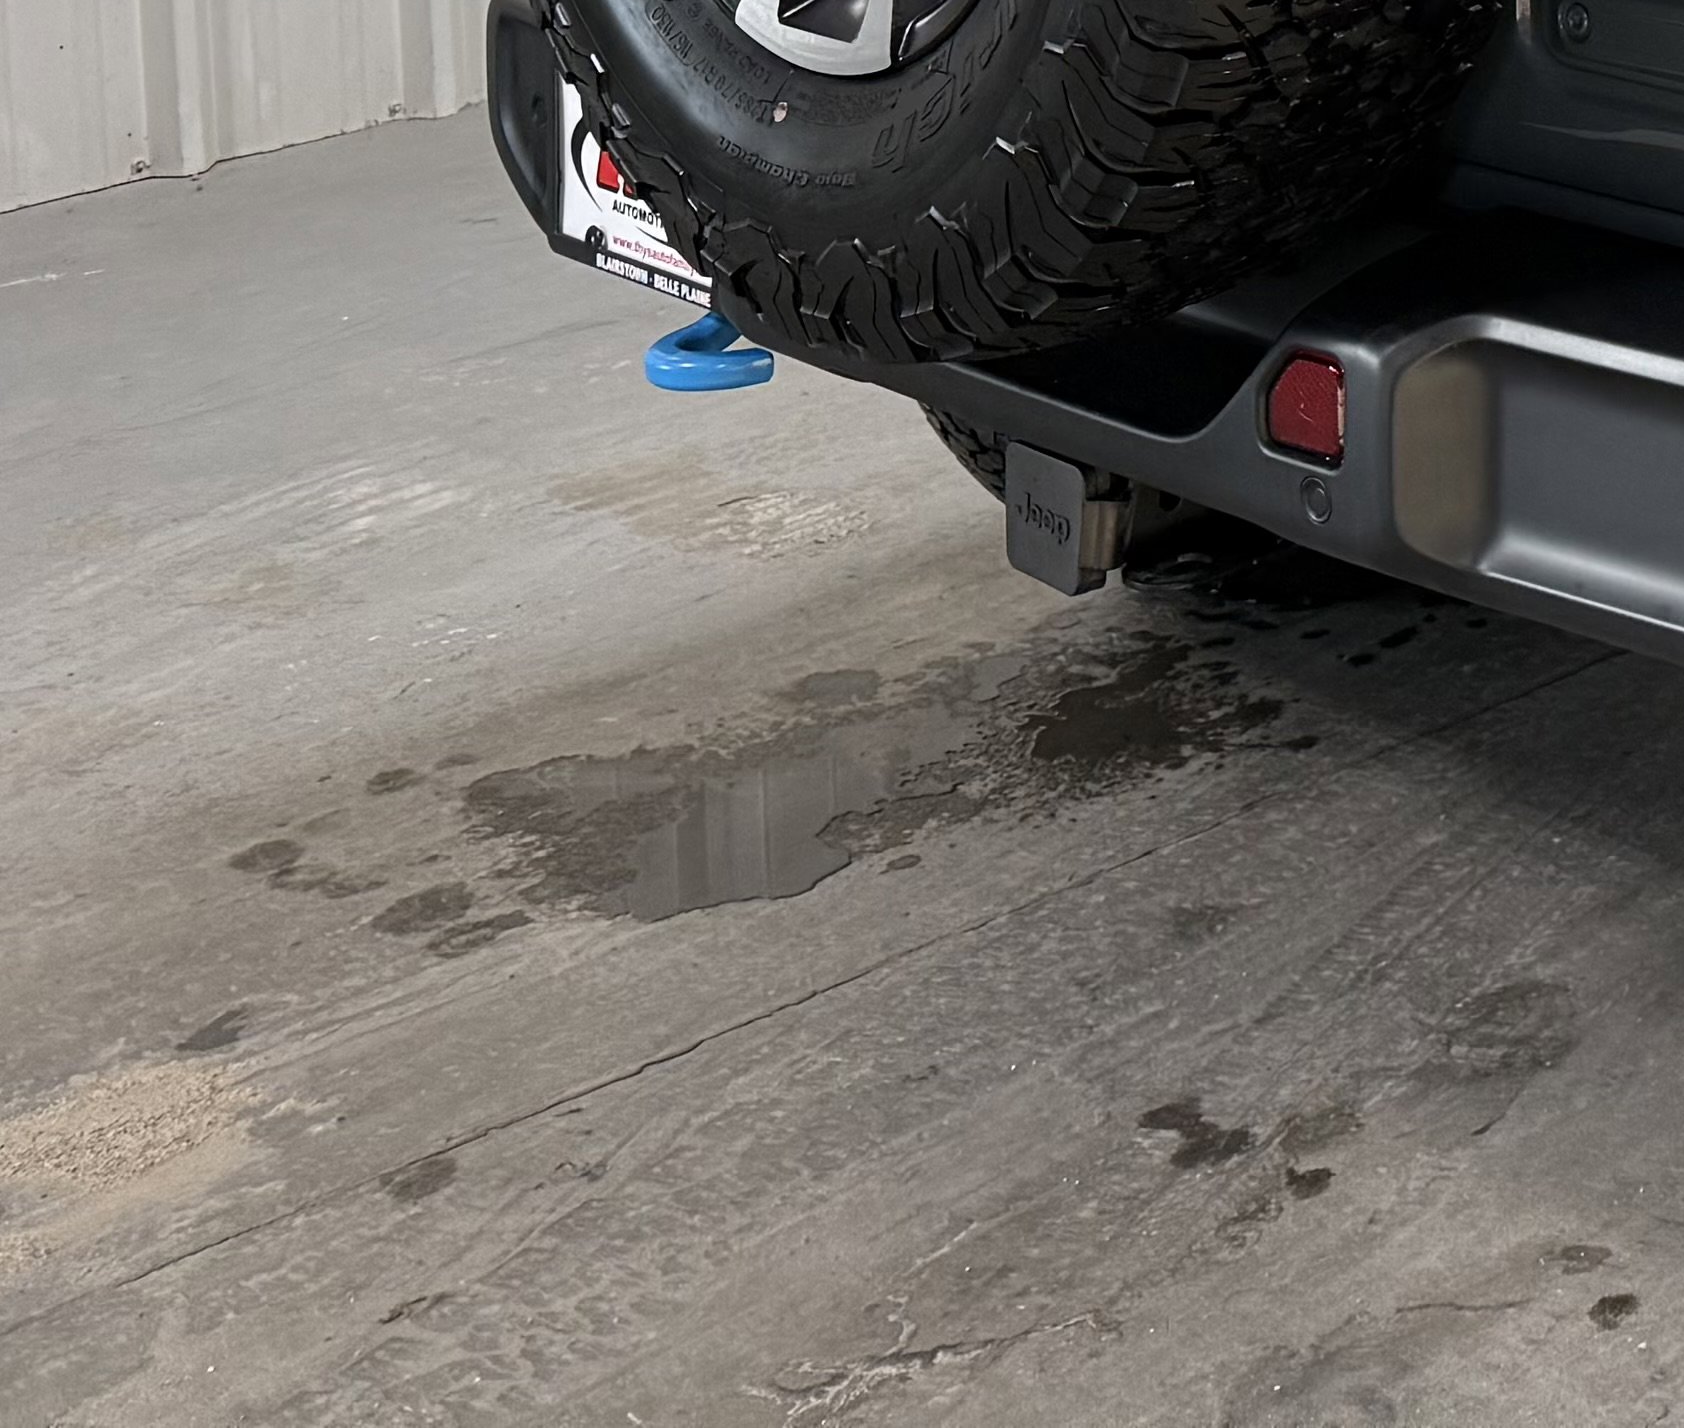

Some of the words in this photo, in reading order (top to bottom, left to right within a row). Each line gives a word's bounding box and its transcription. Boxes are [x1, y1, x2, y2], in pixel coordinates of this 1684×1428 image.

[595, 251, 649, 285] BLAIRSTOWN
[653, 272, 681, 298] BELLE
[680, 283, 713, 310] PLAINE
[1015, 491, 1071, 546] Jeep
